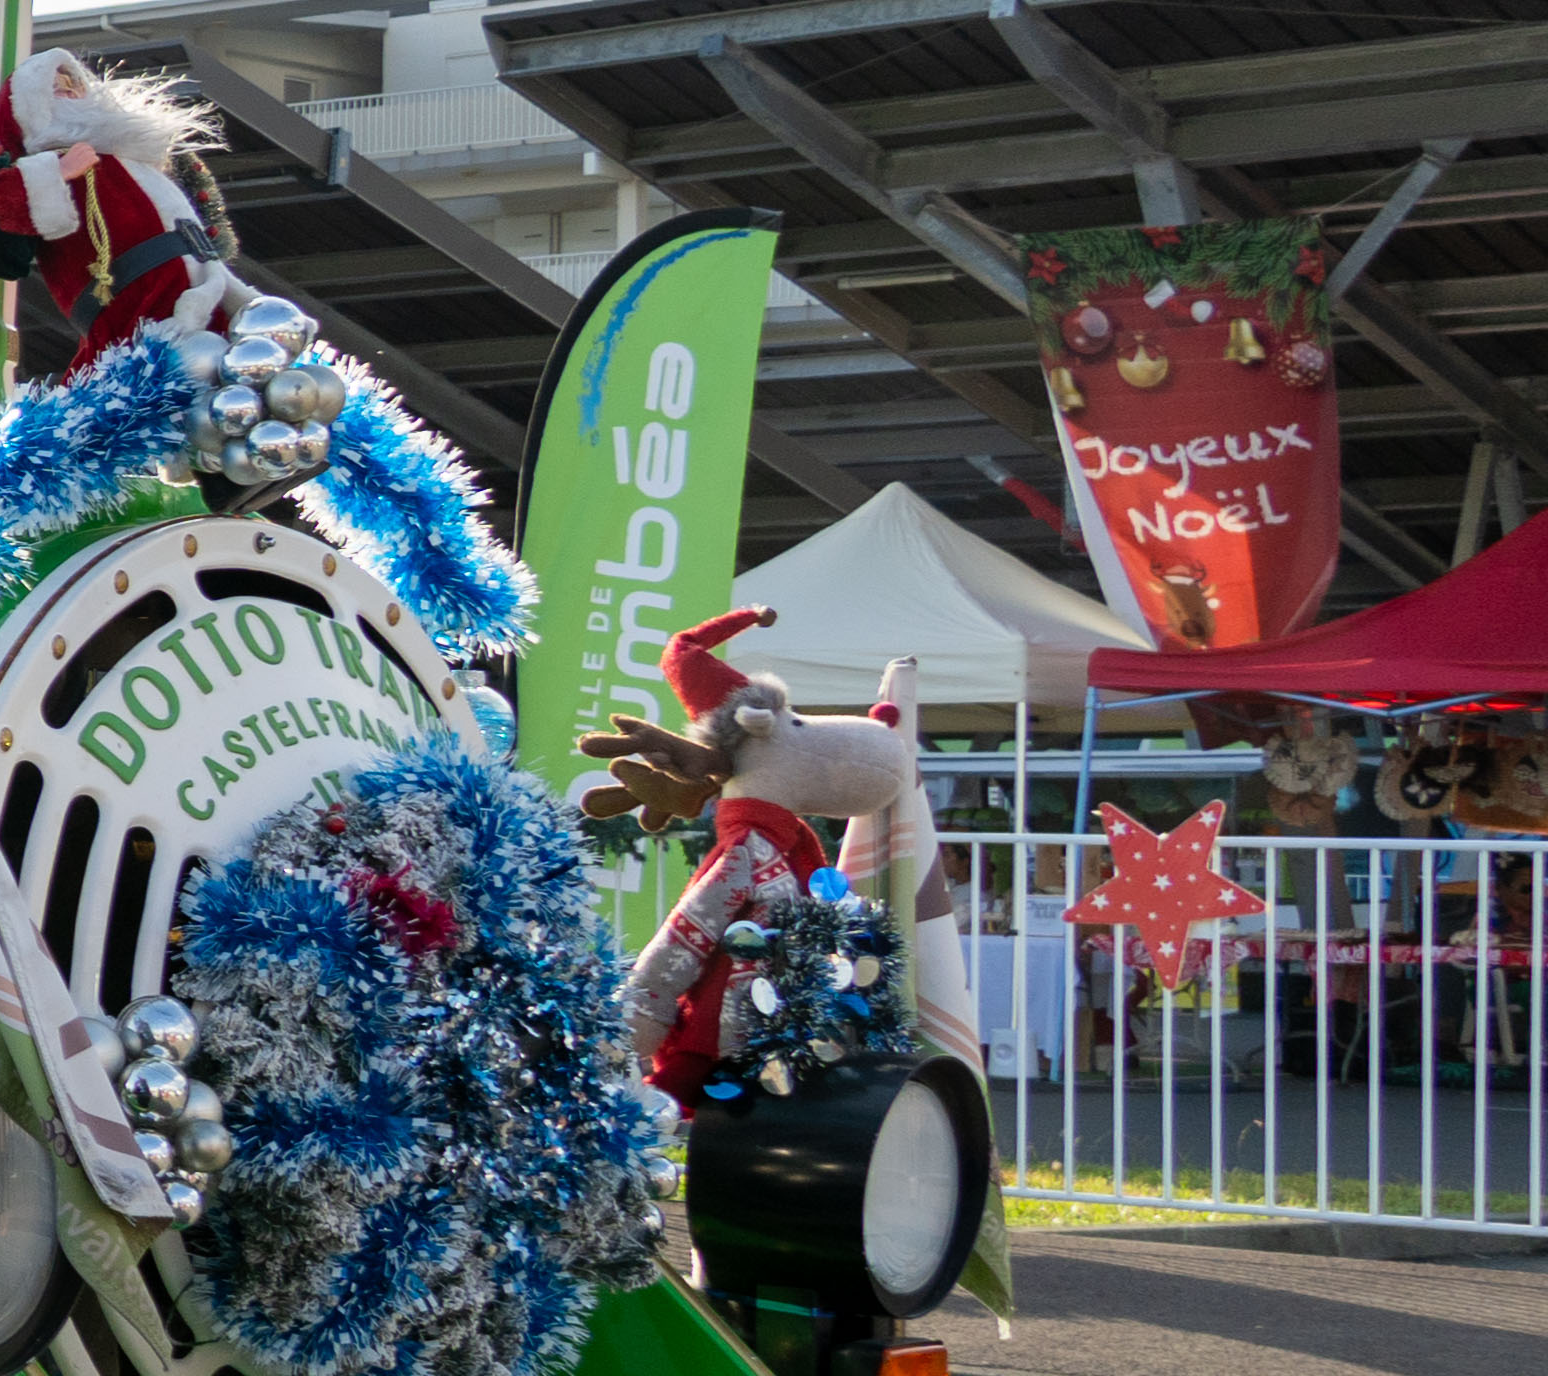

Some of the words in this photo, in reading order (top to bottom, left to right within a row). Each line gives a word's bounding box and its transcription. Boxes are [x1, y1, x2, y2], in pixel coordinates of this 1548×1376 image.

[1074, 423, 1312, 499] Joyeux
[587, 585, 613, 634] DE
[77, 603, 286, 785] DOTTO
